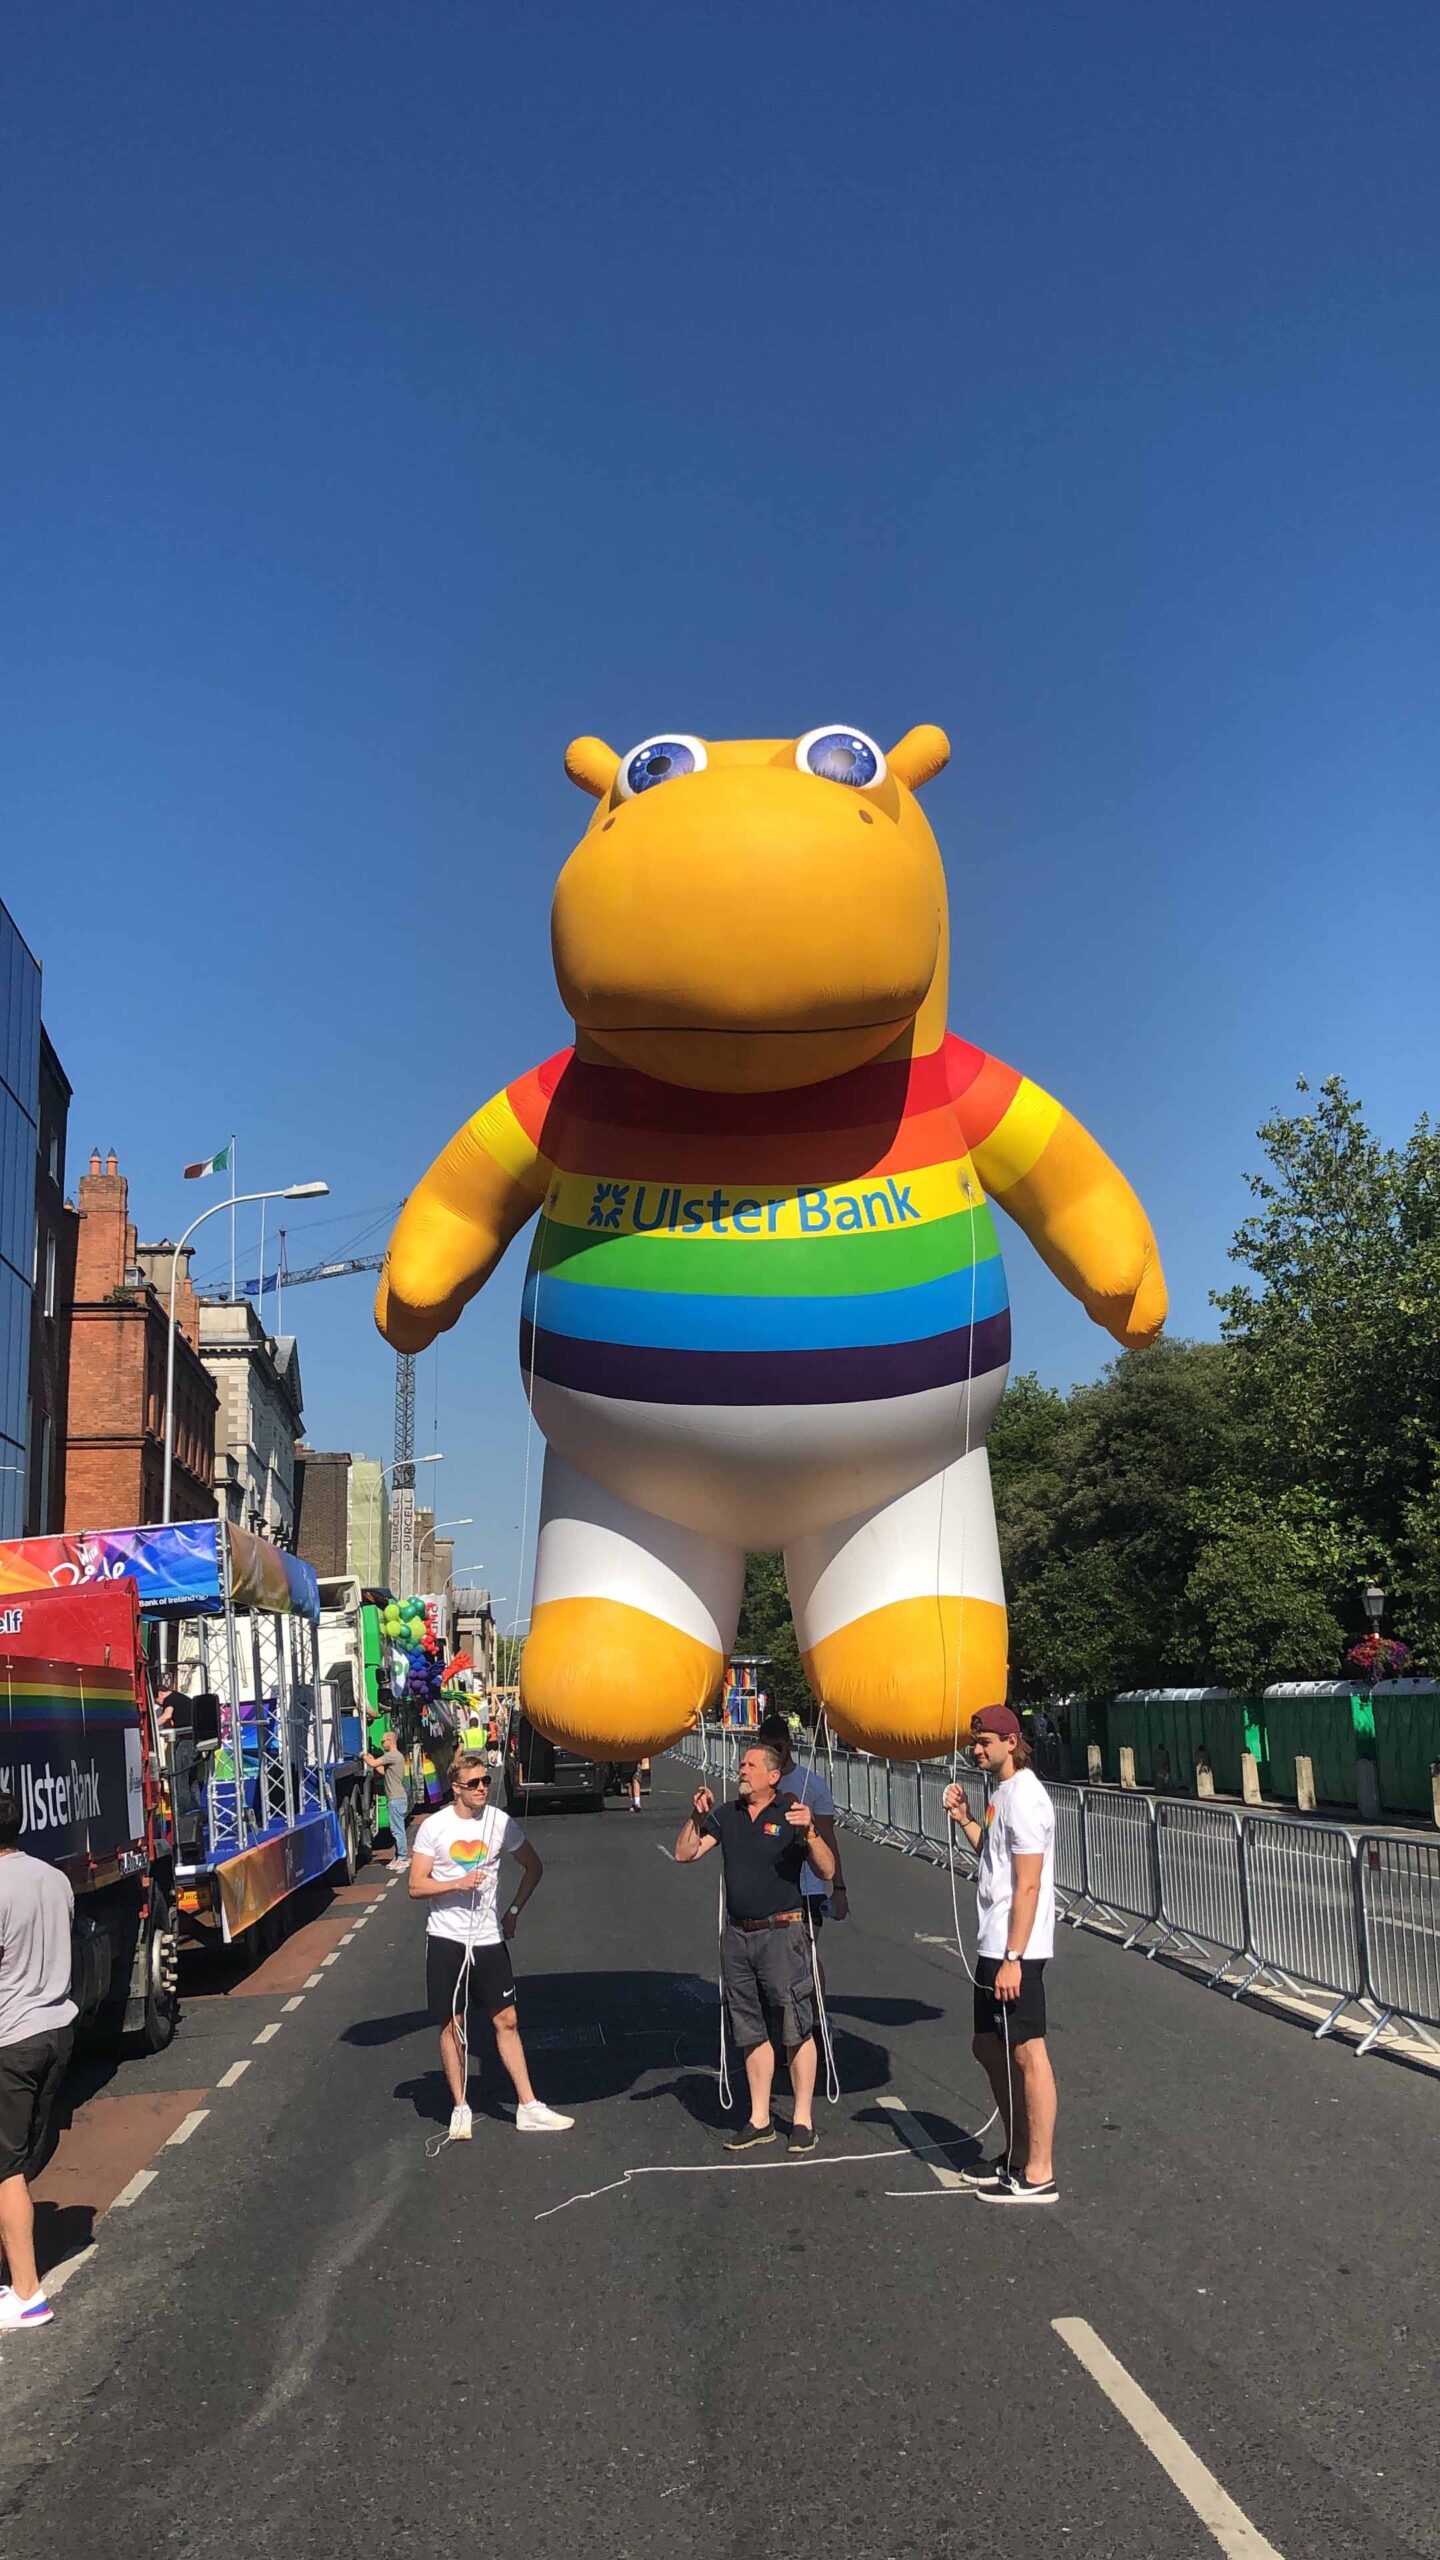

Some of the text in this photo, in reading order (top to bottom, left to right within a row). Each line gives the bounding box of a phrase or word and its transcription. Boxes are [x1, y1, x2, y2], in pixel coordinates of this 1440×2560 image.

[632, 1178, 922, 1233] Ulster Bank
[392, 1497, 401, 1553] PURCELL
[403, 1496, 413, 1551] PURCELL
[138, 1594, 195, 1608] Bank of Ireland
[70, 1758, 101, 1821] Bank
